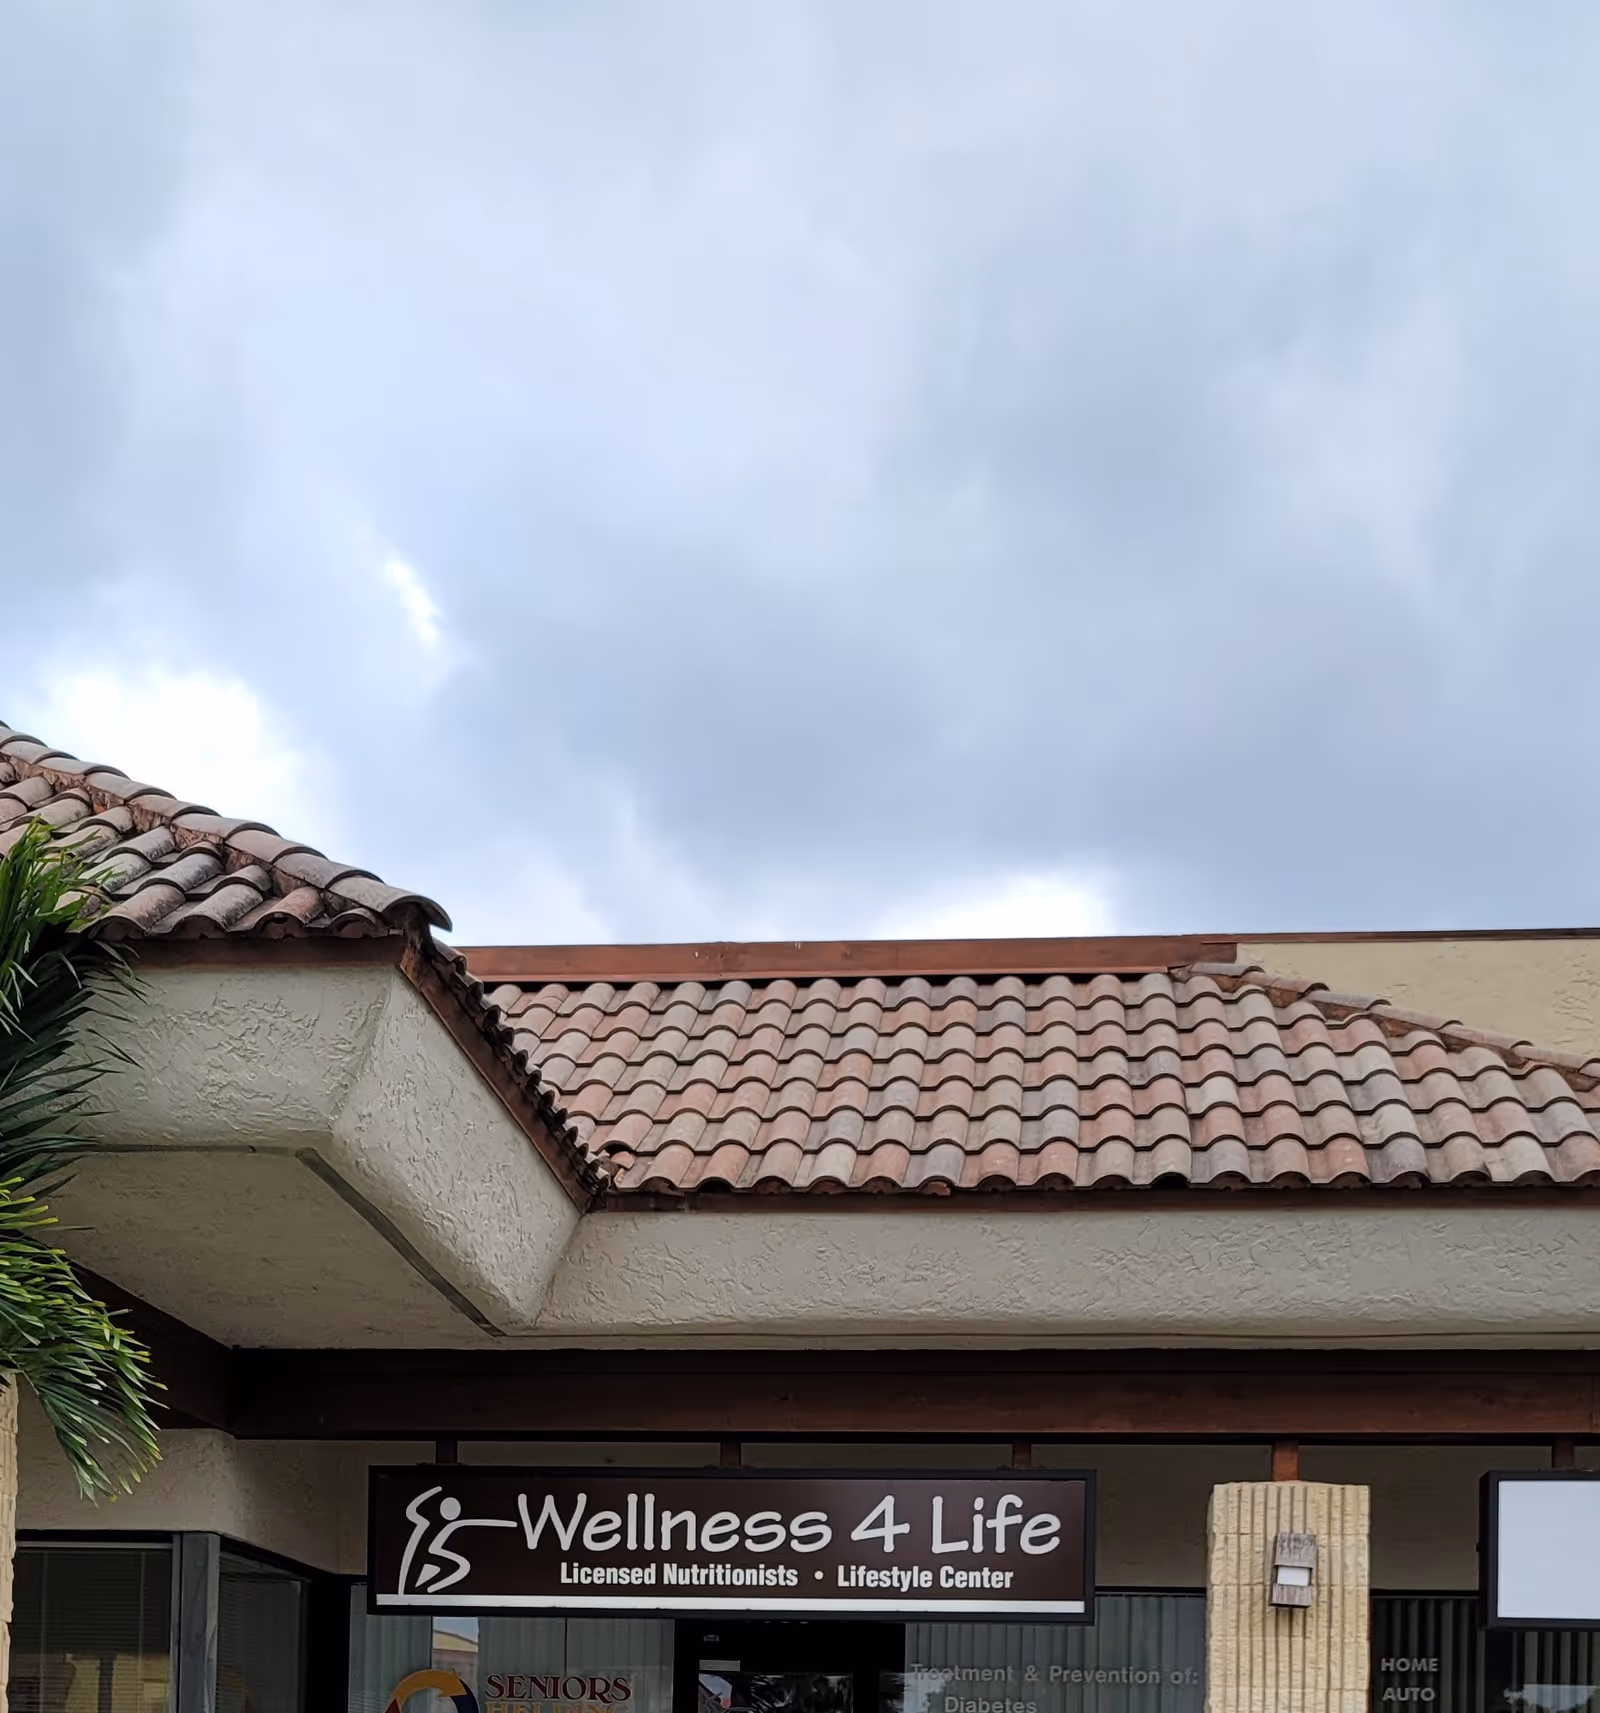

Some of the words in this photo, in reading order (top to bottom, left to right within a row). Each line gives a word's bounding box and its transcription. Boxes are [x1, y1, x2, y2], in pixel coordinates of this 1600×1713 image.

[517, 1493, 832, 1553] Wellness
[850, 1495, 910, 1553] 4
[932, 1494, 1061, 1555] Life
[561, 1562, 657, 1586] Licensed
[663, 1563, 798, 1587] Nutritionists
[837, 1565, 933, 1593] Lifestyle
[939, 1566, 1014, 1589] Center
[911, 1664, 1013, 1682] Treatment
[1024, 1666, 1039, 1681] &
[1049, 1666, 1160, 1685] Prevention
[1170, 1669, 1198, 1685] of:
[1381, 1657, 1440, 1672] HOME
[485, 1674, 631, 1704] SENIORS
[1382, 1687, 1436, 1702] AUTO
[944, 1697, 1037, 1713] Diabetes
